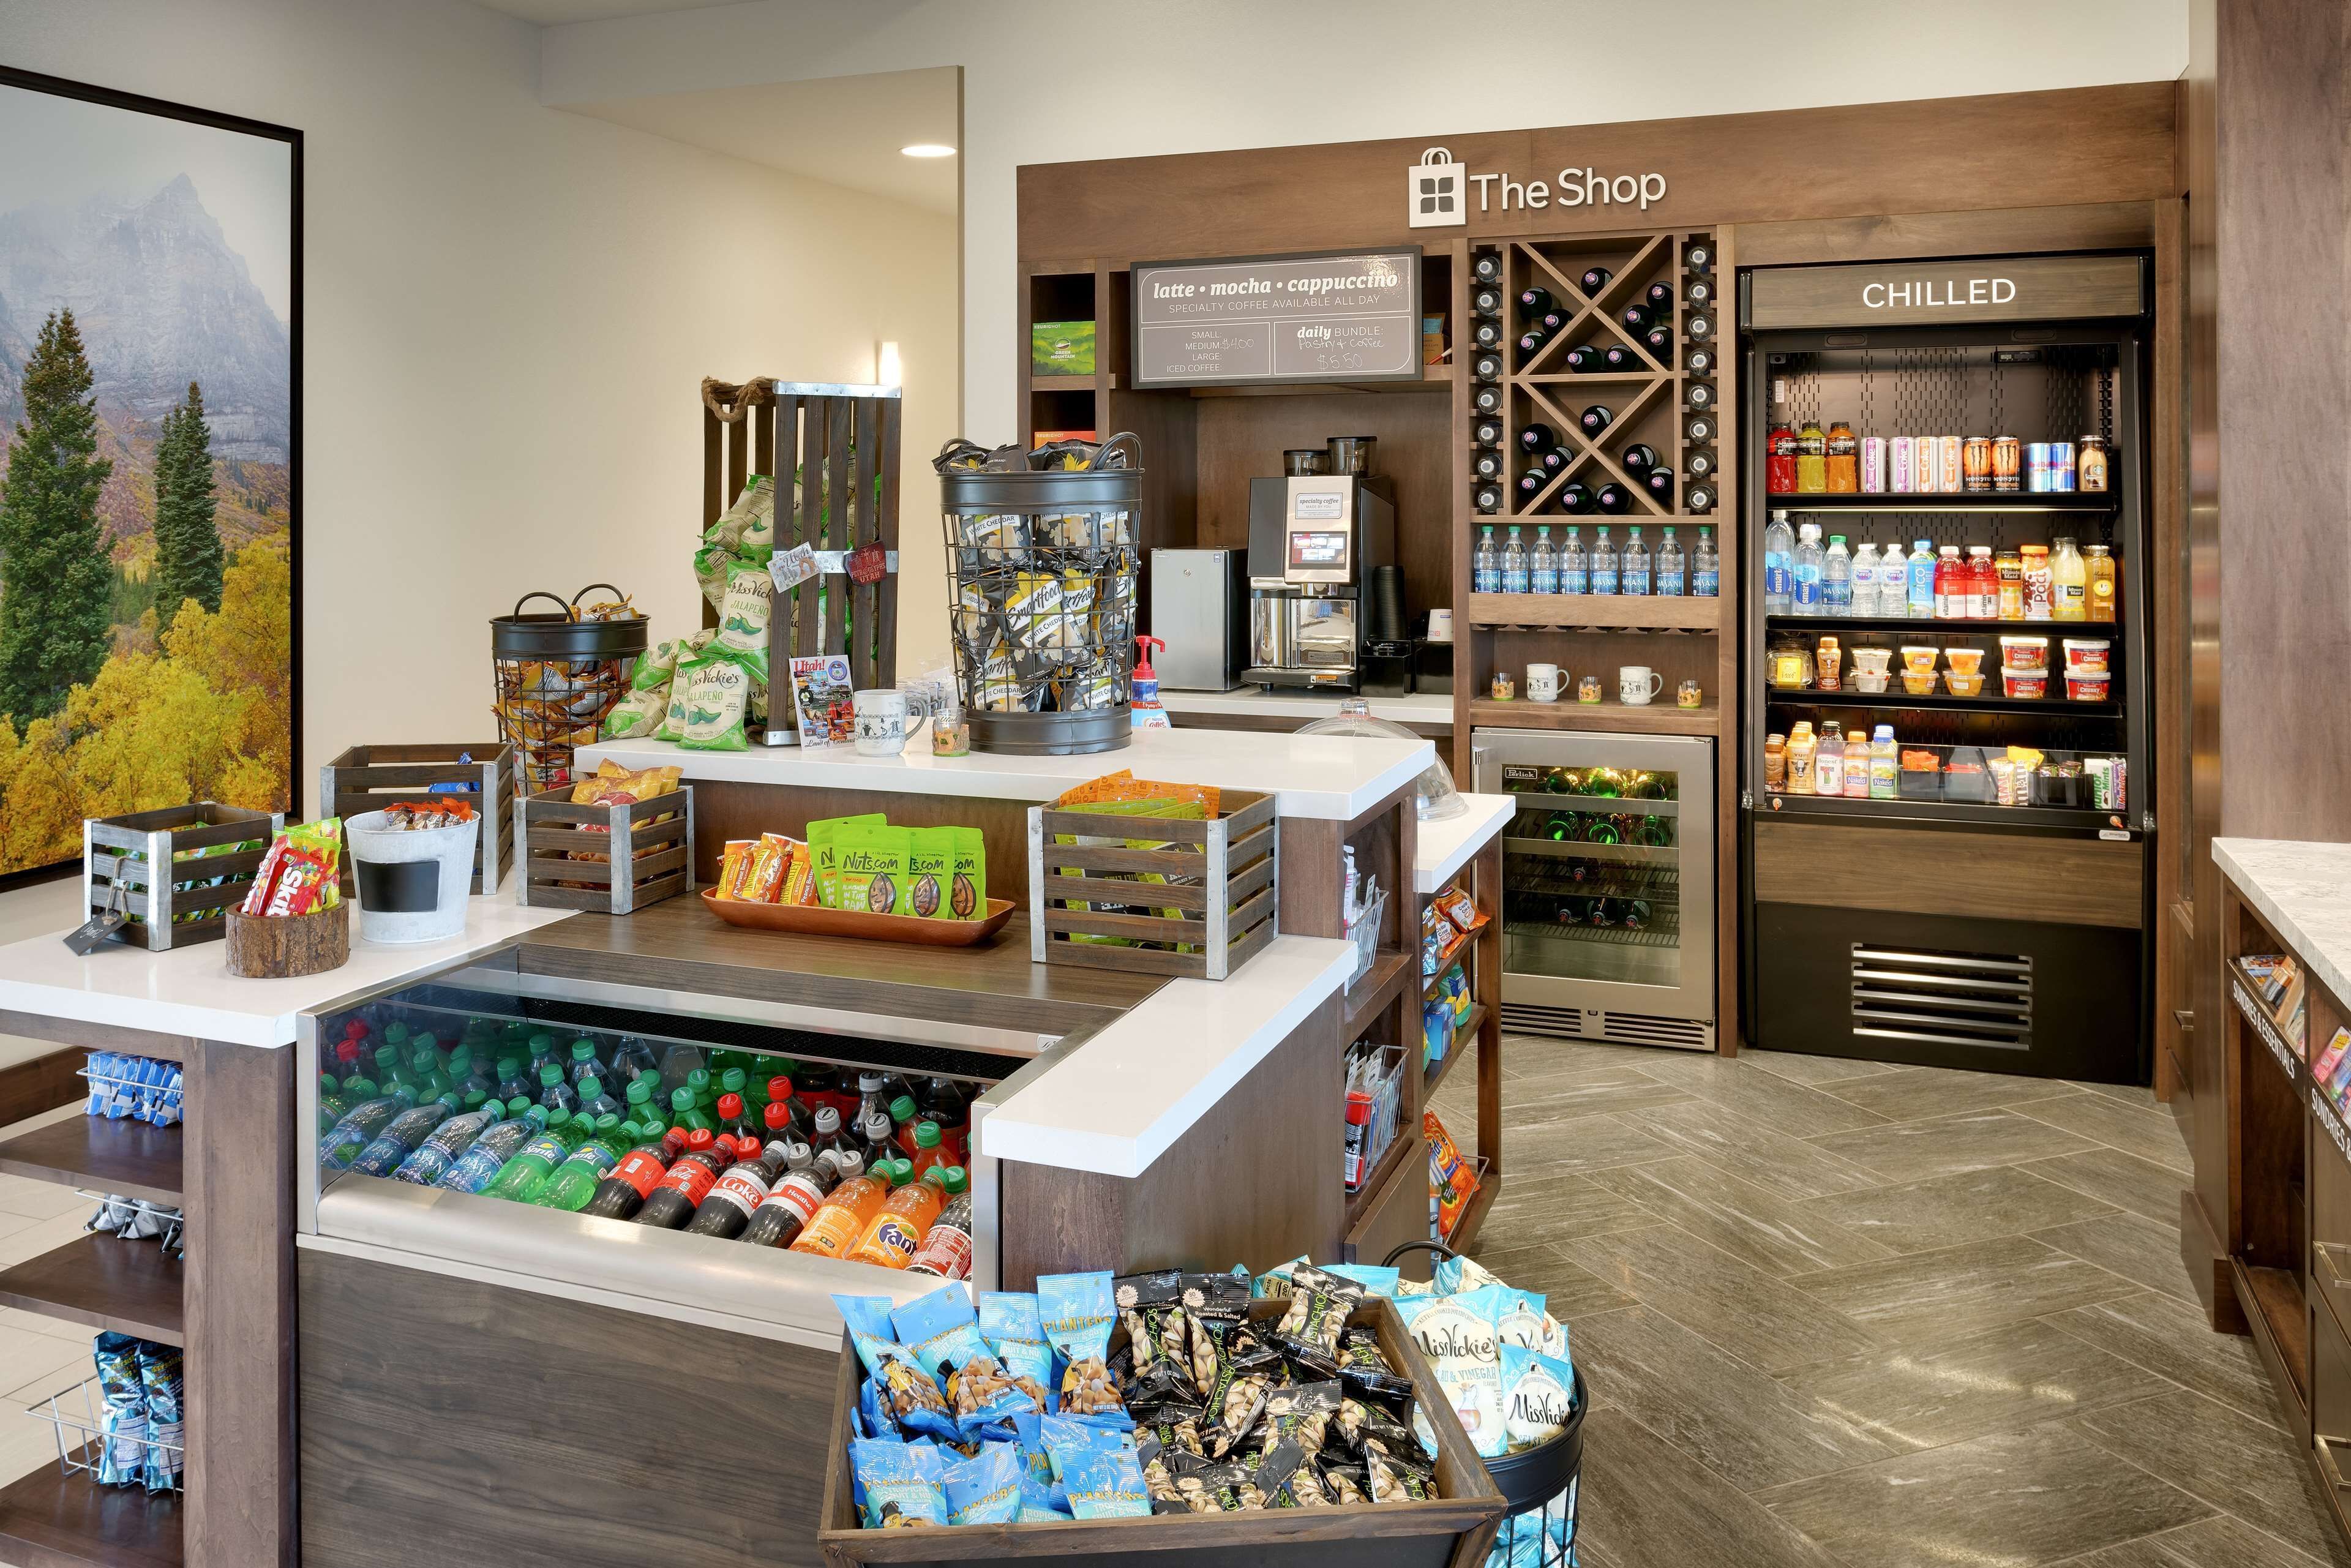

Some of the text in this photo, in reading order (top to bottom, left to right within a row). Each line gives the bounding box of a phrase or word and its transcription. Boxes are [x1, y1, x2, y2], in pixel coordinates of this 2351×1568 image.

[1469, 167, 1667, 211] The Shop
[1153, 271, 1398, 299] latte mocha cappuccino
[1863, 279, 2016, 308] CHILLED
[1169, 294, 1381, 314] SPECIALTY COFFEE AVAILABLE ALL DAY
[1191, 331, 1222, 340] SMALL:
[1297, 326, 1384, 340] daily BUNDLE:
[1185, 342, 1222, 351] MEDIUM:
[1192, 352, 1222, 361] LARGE:
[1317, 354, 1362, 371] $5.50
[1166, 363, 1222, 373] ICED COFFEE:
[1622, 578, 1645, 587] DASANI
[1693, 579, 1718, 587] DASANI
[752, 580, 771, 604] Vick
[1823, 587, 1848, 596] DASANI
[730, 600, 769, 617] JALAPEÑO
[793, 659, 825, 672] Utah!
[702, 667, 740, 690] Vickie's
[800, 883, 810, 902] Peanut
[852, 891, 866, 900] THE
[844, 900, 866, 911] RAW
[2233, 980, 2257, 1026] SUNDRIES
[2262, 1022, 2295, 1079] ESSENTIALS
[2311, 1087, 2345, 1152] SUNDRIES
[522, 1144, 555, 1159] Sprite
[459, 1156, 491, 1183] DASA
[722, 1177, 759, 1206] Coke
[787, 1188, 814, 1212] Heather
[879, 1224, 918, 1256] Fant
[1419, 1310, 1434, 1324] KETTLE
[1441, 1324, 1497, 1363] Vickie's
[1460, 1366, 1497, 1379] VINEGAR
[1509, 1393, 1543, 1424] Miss
